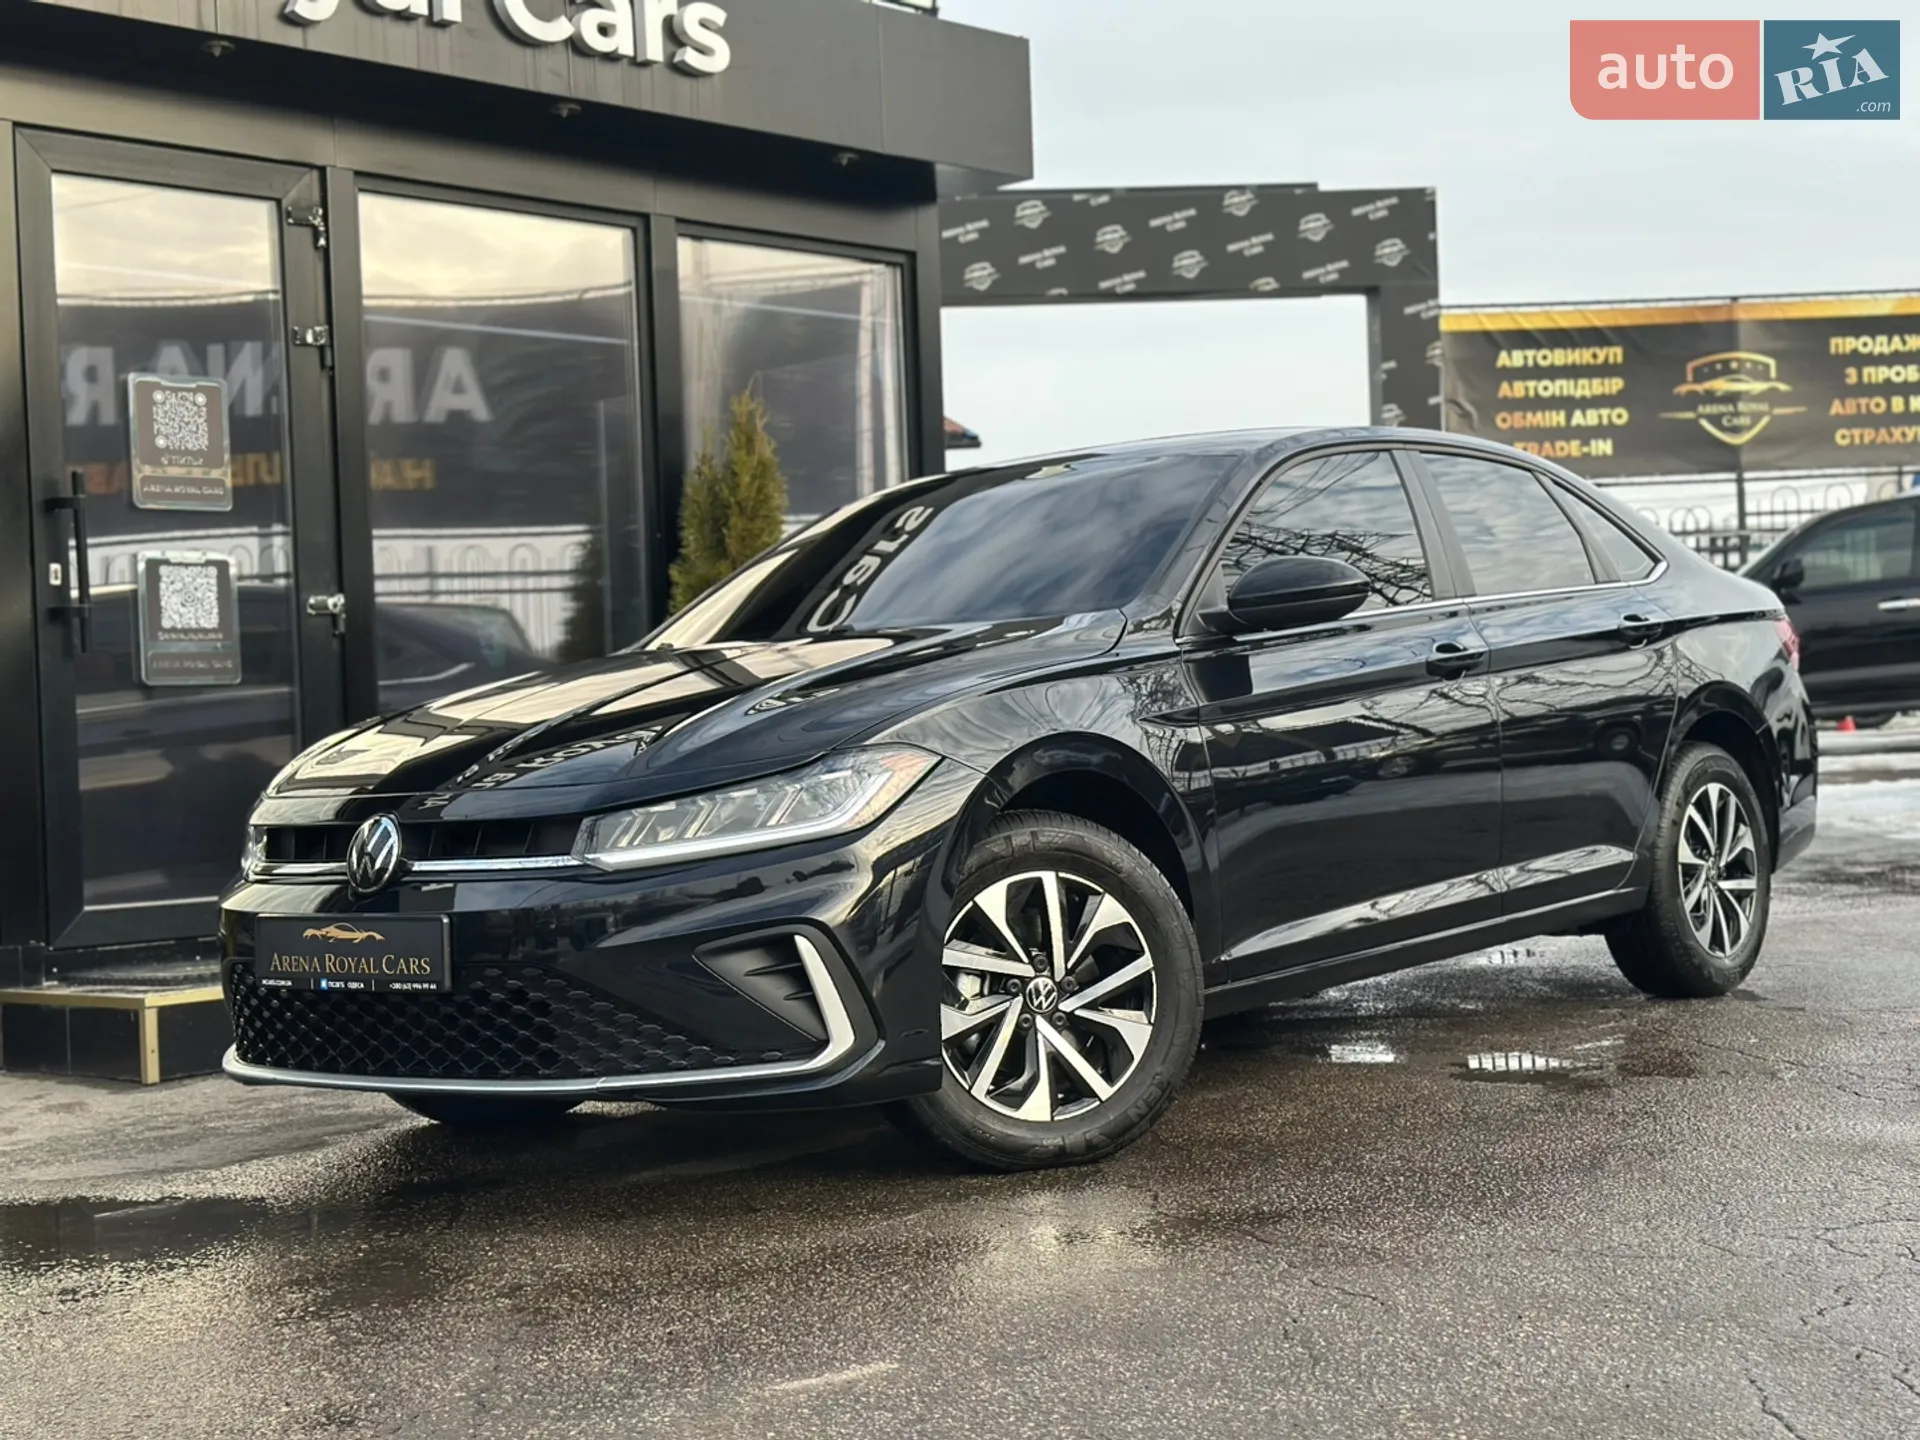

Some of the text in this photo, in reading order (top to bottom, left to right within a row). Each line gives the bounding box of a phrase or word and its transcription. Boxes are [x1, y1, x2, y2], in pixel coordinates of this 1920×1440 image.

[1496, 346, 1623, 368] АВТОВИКУП
[1498, 376, 1625, 399] АВТОПІДБІР
[1829, 396, 1887, 416] АВТО
[1891, 395, 1905, 413] В
[1495, 407, 1629, 430] ОБМІН АВТО
[1835, 425, 1920, 446] СТРАХУ
[270, 952, 431, 975] ARENA ROYAL CARS
